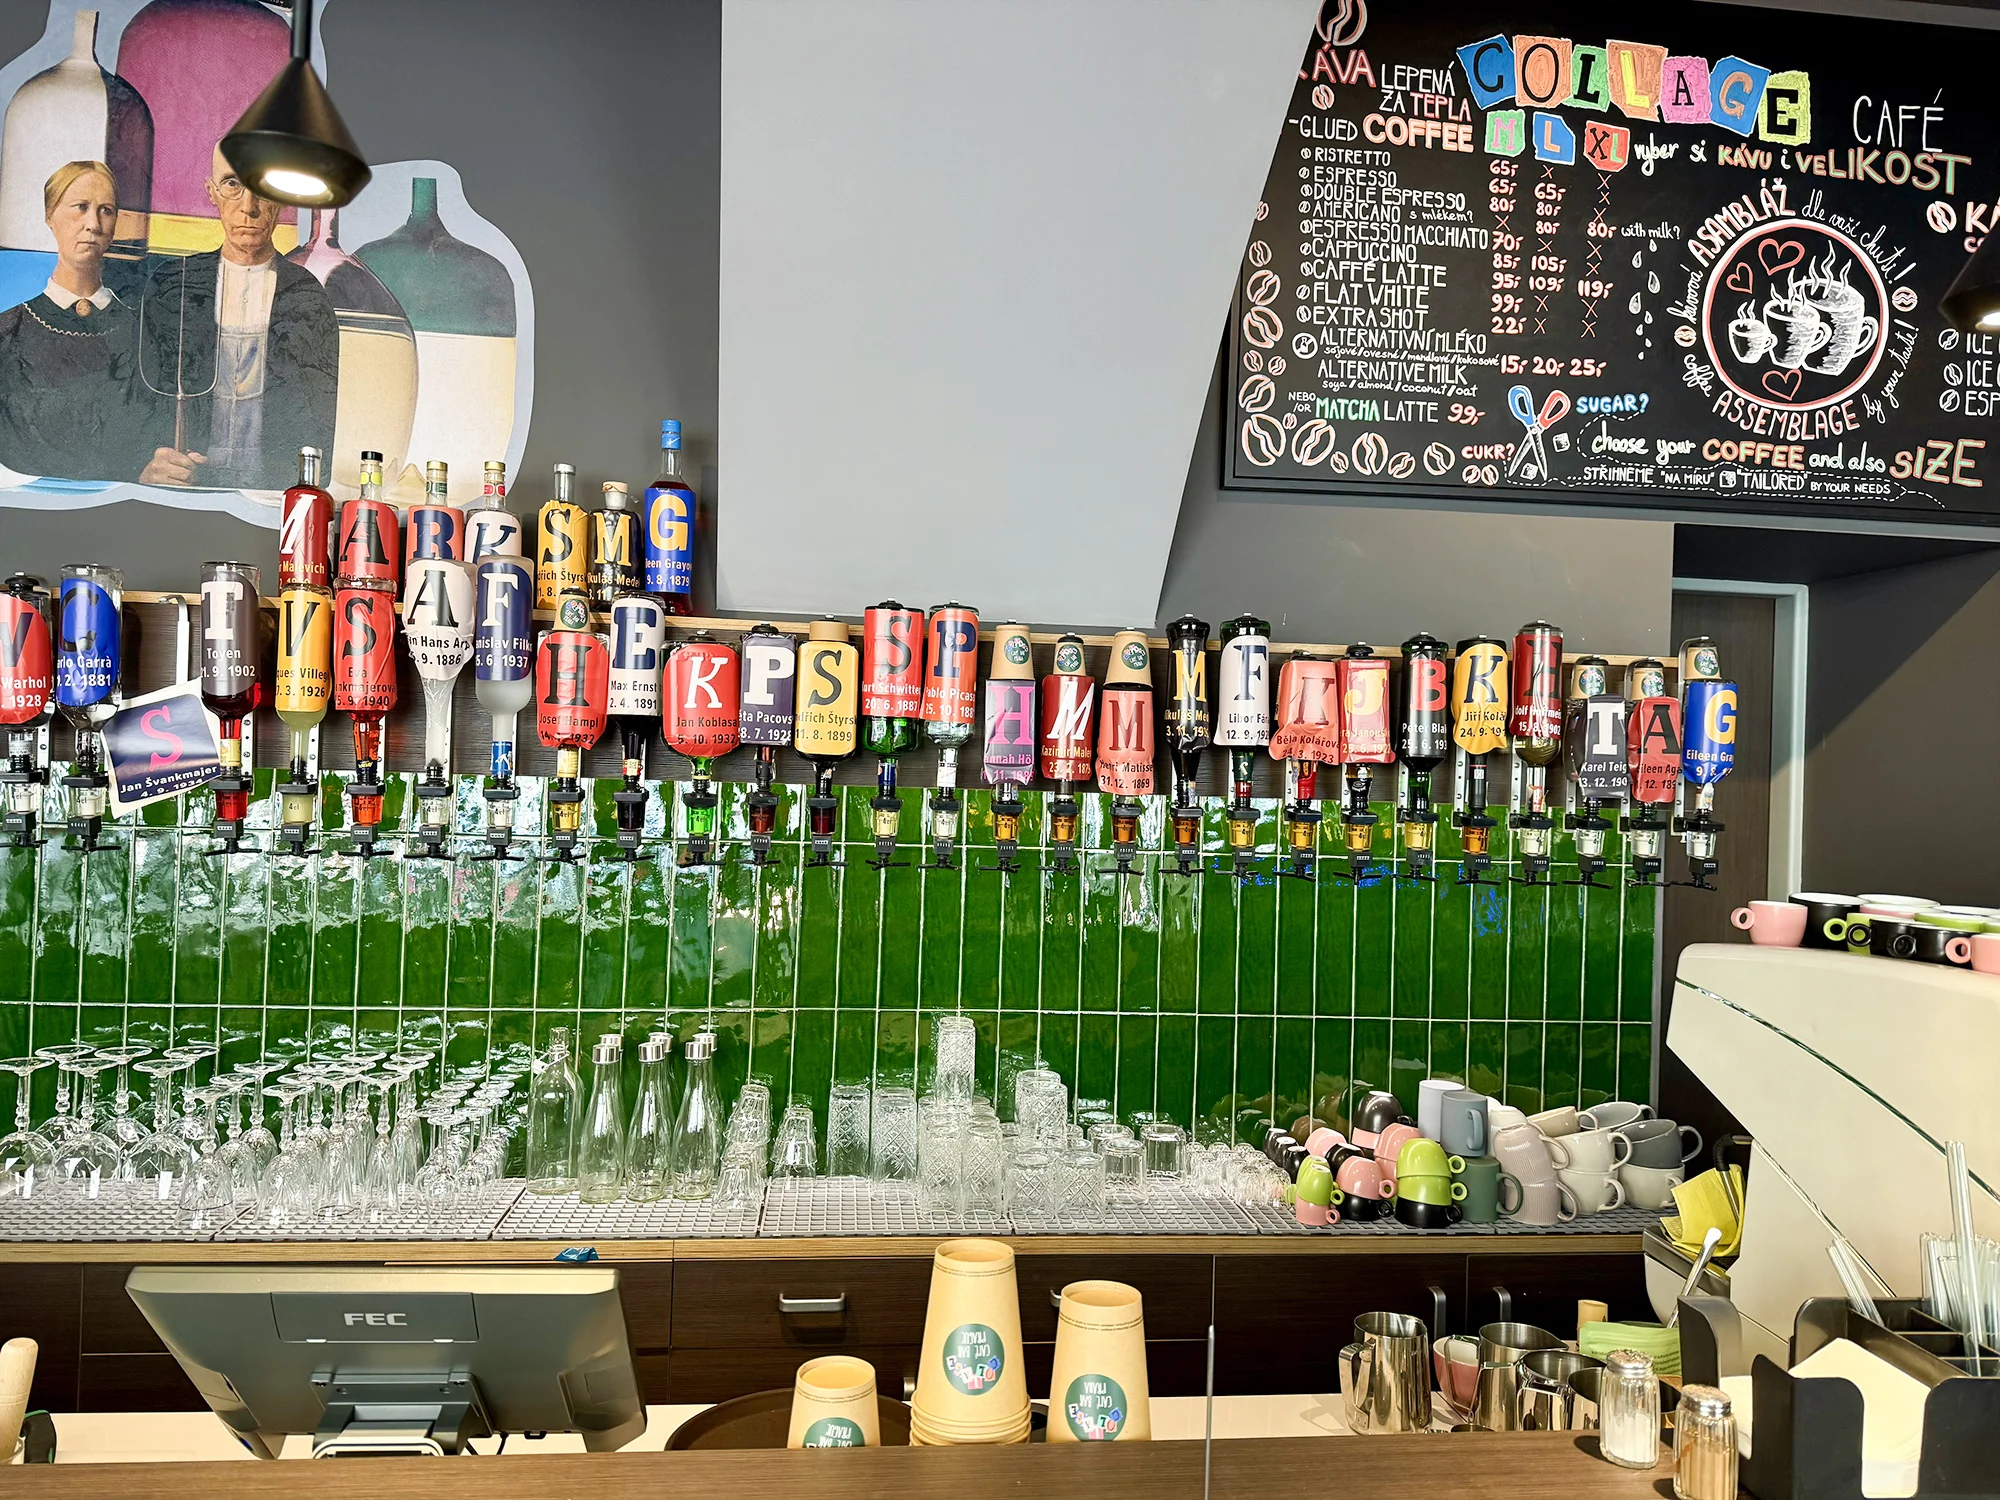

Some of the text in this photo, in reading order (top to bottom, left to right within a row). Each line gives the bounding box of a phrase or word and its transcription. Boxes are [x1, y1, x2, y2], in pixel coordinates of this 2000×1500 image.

[1299, 42, 1376, 87] ÁVA
[1381, 61, 1456, 96] LEPENÁ
[1473, 42, 1799, 135] COLLAGE
[1379, 89, 1472, 123] ZA TEPLA
[1853, 88, 1945, 153] CAFÉ
[1362, 113, 1474, 153] COFFEE
[1588, 127, 1623, 164] XL
[1314, 147, 1391, 166] RISTRETTO
[1690, 140, 1708, 162] si
[1718, 143, 1772, 170] KÁVU
[1781, 148, 1791, 170] i
[1795, 147, 1972, 195] VELIKOST
[1313, 166, 1397, 188] ESPRESSO
[1313, 183, 1377, 204] DOUBLE
[1382, 187, 1466, 211] ESPRESSO
[1801, 188, 1825, 221] dle
[1312, 201, 1400, 223] AMERICANO
[1422, 209, 1474, 223] mlékem?
[1621, 222, 1646, 238] with
[1649, 222, 1681, 240] milk?
[1312, 220, 1400, 243] ESPRESSO
[1404, 225, 1489, 250] MACCHIATO
[1688, 177, 1796, 268] ASAMBLÁŽ
[1312, 238, 1417, 263] CAPPUCCINO
[1313, 260, 1376, 282] CAFFÉ
[1382, 263, 1447, 287] LATTE
[1313, 281, 1362, 306] FLAT
[1368, 285, 1429, 309] WHITE
[1312, 305, 1378, 328] EXTRA
[1380, 308, 1429, 331] SHOT
[1320, 326, 1487, 354] ALTERNATIVNÍ MLÉKO
[1318, 359, 1425, 383] ALTERNATIVE
[1429, 365, 1468, 386] MILK
[1683, 353, 1712, 398] coffee
[1861, 318, 1919, 424] by your taste!
[1966, 360, 1993, 387] ICE
[1288, 391, 1315, 402] NEBO
[1315, 398, 1380, 422] MATCHA
[1384, 401, 1438, 423] LATTE
[1576, 392, 1650, 415] SUGAR?
[1712, 389, 1860, 442] ASSEMBLAGE
[1461, 443, 1515, 461] CUKR?
[1591, 420, 1986, 488] choose your COFFEE and also SIZE
[1810, 481, 1822, 493] BY
[1822, 481, 1851, 494] YOUR
[1854, 481, 1891, 495] NEEDS
[340, 508, 390, 565] A
[541, 508, 573, 567] S
[593, 512, 632, 567] M
[650, 495, 689, 551] G
[202, 581, 243, 640] T
[407, 570, 459, 628] A
[482, 572, 518, 626] F
[283, 600, 321, 658] V
[341, 596, 377, 661] S
[421, 635, 450, 649] Hans
[612, 606, 657, 670] E
[880, 615, 912, 676] S
[206, 647, 242, 662] Toyen
[435, 653, 462, 667] 1886
[502, 655, 529, 668] 1937
[934, 621, 976, 679] P
[229, 666, 256, 678] 1902
[544, 642, 592, 707] H
[610, 680, 658, 693] Max Ernst
[683, 656, 729, 709] K
[743, 646, 795, 706] P
[807, 650, 842, 709] S
[1172, 650, 1207, 702] M
[1233, 645, 1268, 701] F
[1409, 658, 1447, 712] B
[1463, 655, 1503, 703] K
[10, 694, 42, 708] 1928
[301, 685, 326, 698] 1926
[365, 693, 390, 706] 1940
[634, 699, 657, 710] 1891
[566, 714, 599, 728] Hampl
[675, 716, 738, 728] Jan Koblasa
[988, 685, 1035, 746] H
[1047, 681, 1095, 740] M
[1108, 700, 1146, 752] M
[1705, 689, 1738, 746] G
[141, 705, 184, 772] S
[571, 733, 596, 745] 1932
[713, 733, 736, 745] 1932
[827, 731, 853, 742] 1899
[1276, 733, 1298, 747] Běla
[1588, 701, 1625, 756] T
[1637, 704, 1682, 754] A
[1312, 750, 1334, 764] 1923
[1686, 749, 1717, 761] Eileen
[120, 765, 218, 794] Jan Švankmajer
[173, 778, 203, 790] 1934
[1132, 777, 1151, 789] 1869
[343, 1313, 408, 1326] FEC
